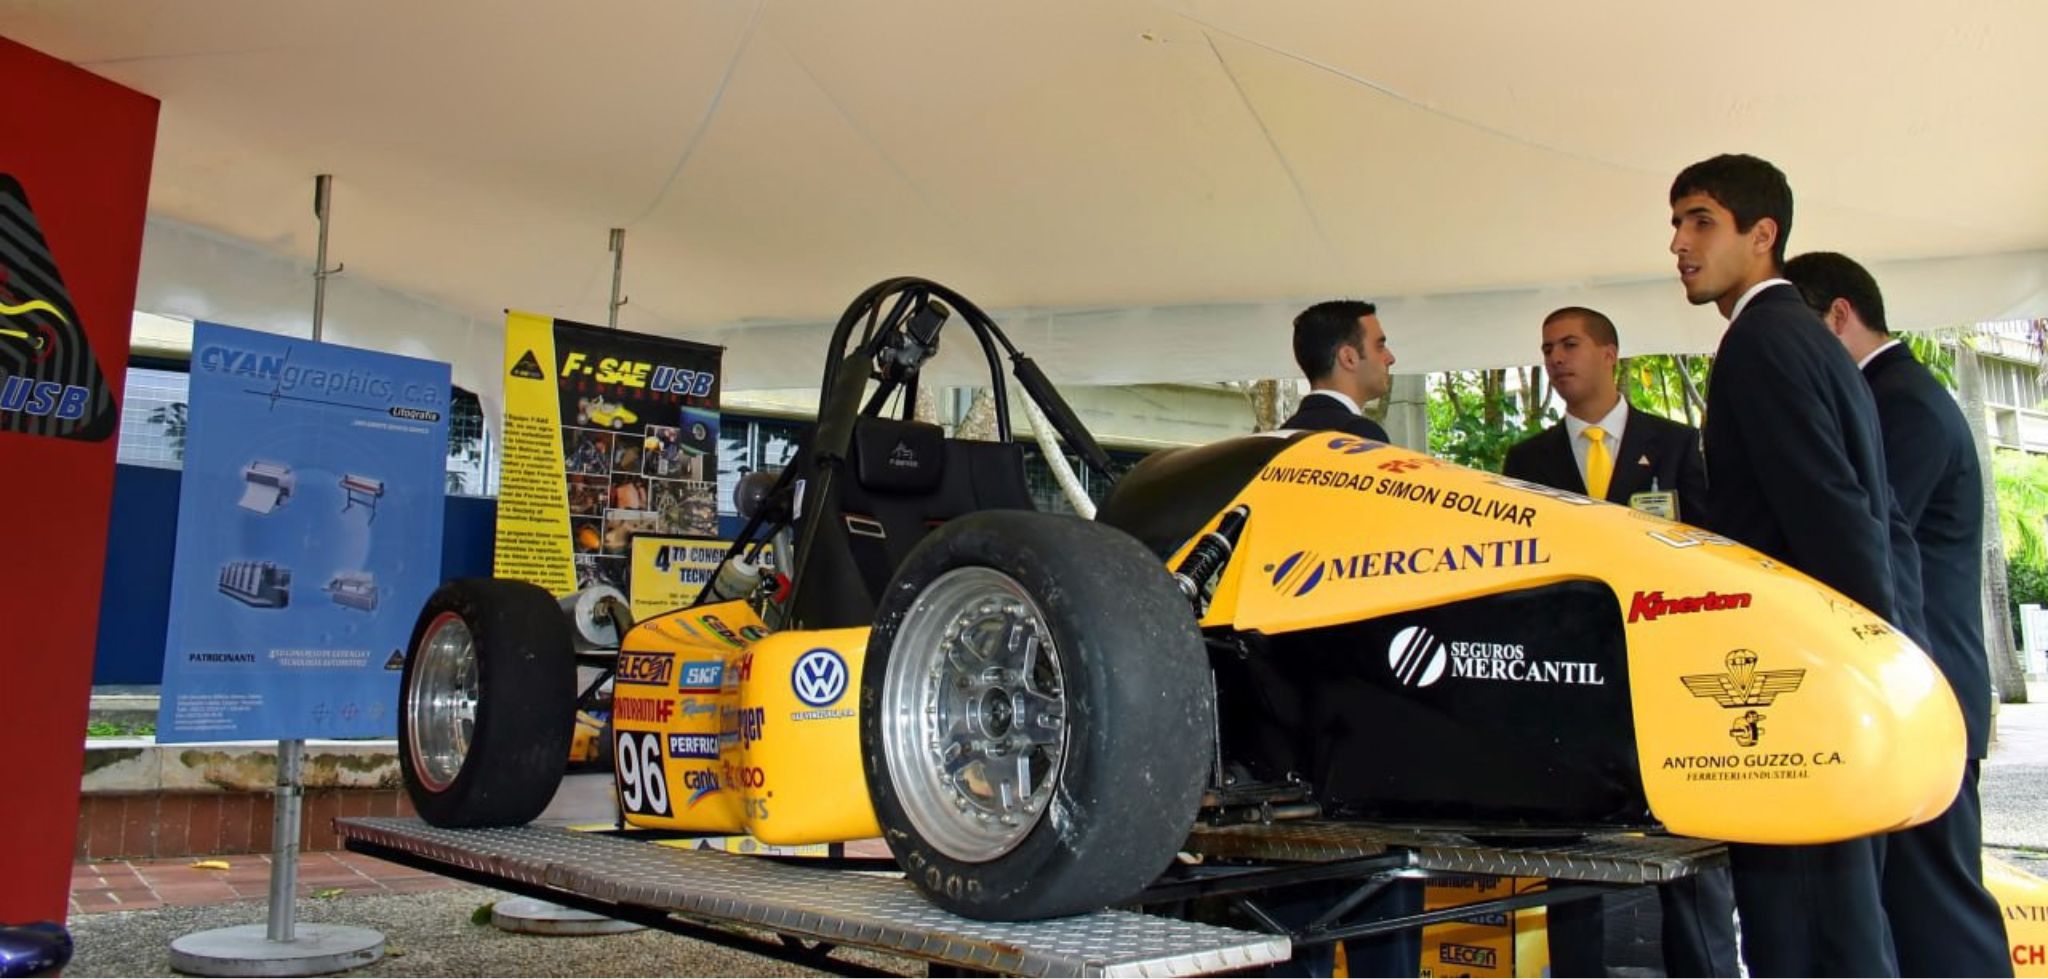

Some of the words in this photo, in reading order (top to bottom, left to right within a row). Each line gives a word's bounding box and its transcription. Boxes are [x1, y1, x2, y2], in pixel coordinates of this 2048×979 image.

[651, 365, 714, 397] USB
[0, 375, 91, 419] USB
[1261, 467, 1374, 492] UNIVERSIDAD
[1376, 478, 1440, 505] SIMON
[1442, 491, 1537, 527] BOLIVAR
[1326, 537, 1551, 581] MERCANTIL
[189, 652, 256, 664] PATROCINANTE
[1450, 641, 1525, 660] SEGUROS
[686, 666, 721, 684] SKF
[1450, 656, 1605, 685] MERCANTIL
[618, 732, 667, 815] 96
[1662, 756, 1740, 769] ANTONIO
[1743, 752, 1807, 768] GUZZO,
[1812, 752, 1846, 766] C.A.
